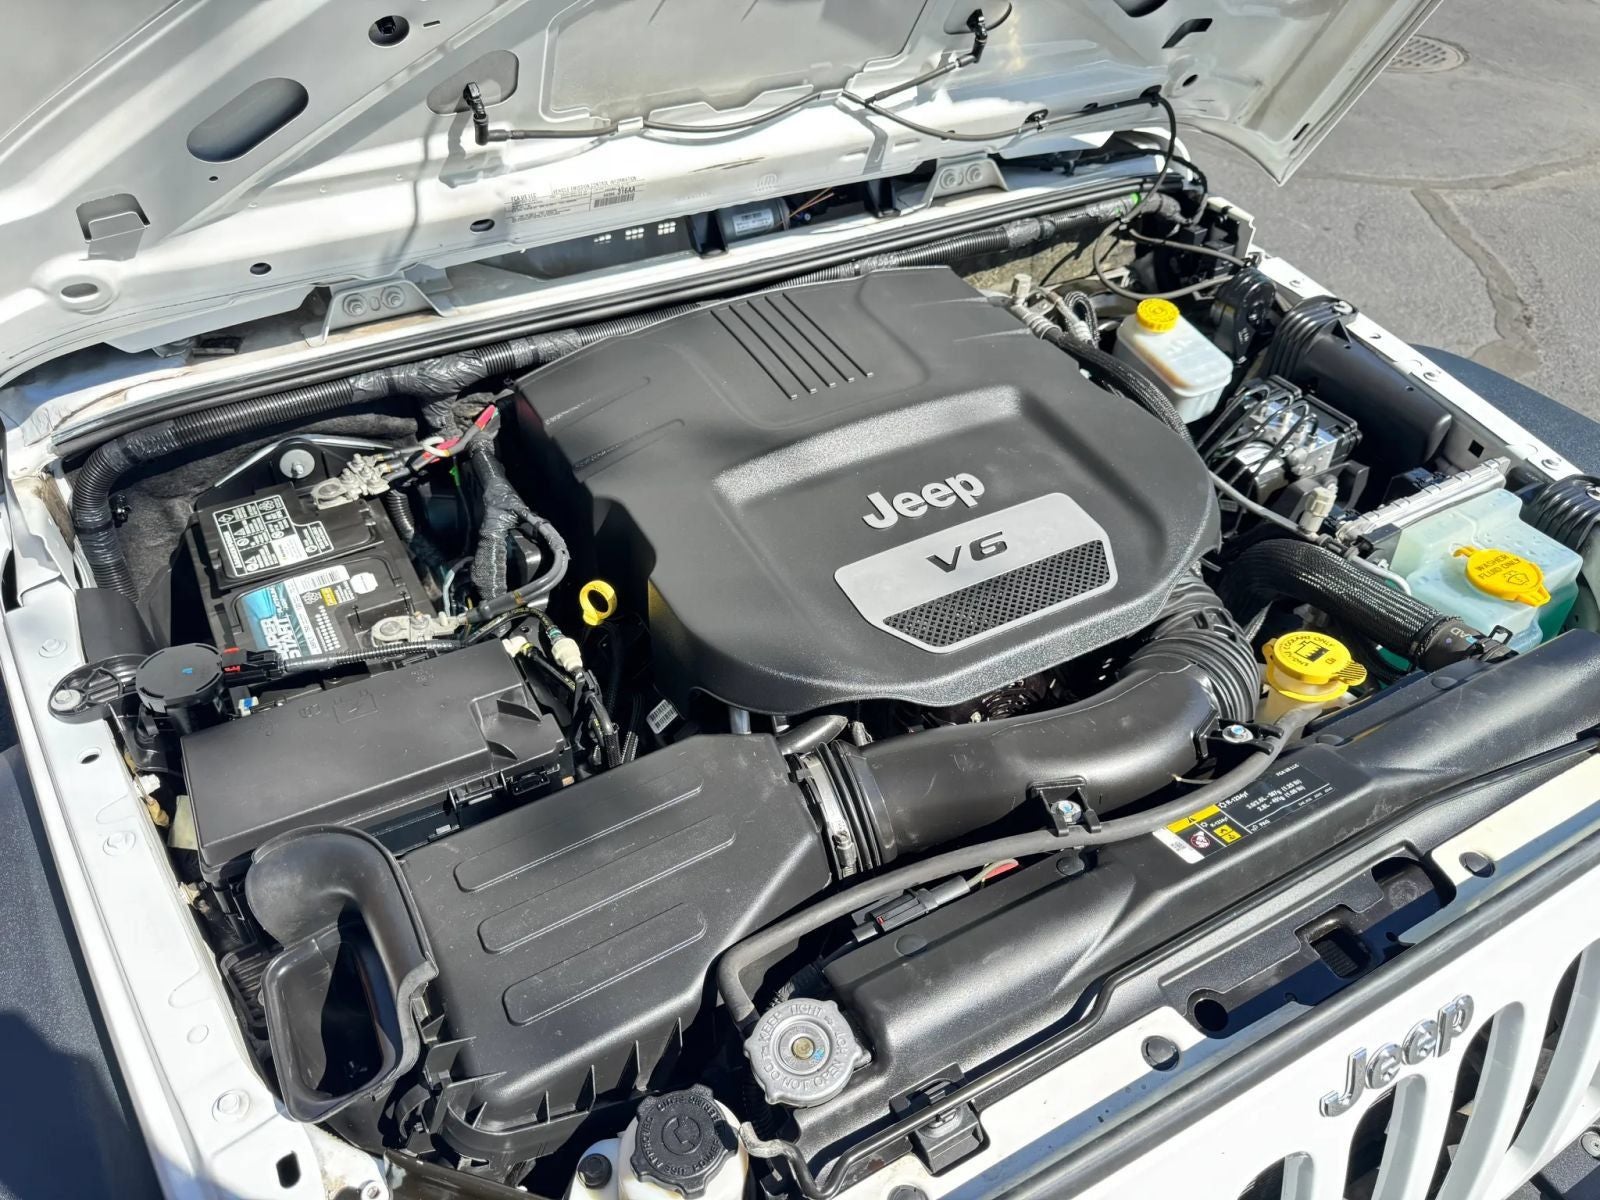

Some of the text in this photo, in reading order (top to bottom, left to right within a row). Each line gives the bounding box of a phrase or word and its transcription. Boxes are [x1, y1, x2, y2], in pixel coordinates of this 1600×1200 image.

[862, 473, 985, 529] Jeep
[926, 531, 1008, 573] V6
[1475, 554, 1509, 571] WASHER
[1478, 557, 1521, 580] FLUID ONLY
[759, 1003, 824, 1043] KEEP TIGHT
[763, 1061, 781, 1081] DO
[781, 1076, 812, 1091] NOT
[813, 1058, 845, 1087] OPEN
[1319, 993, 1475, 1118] Jeep
